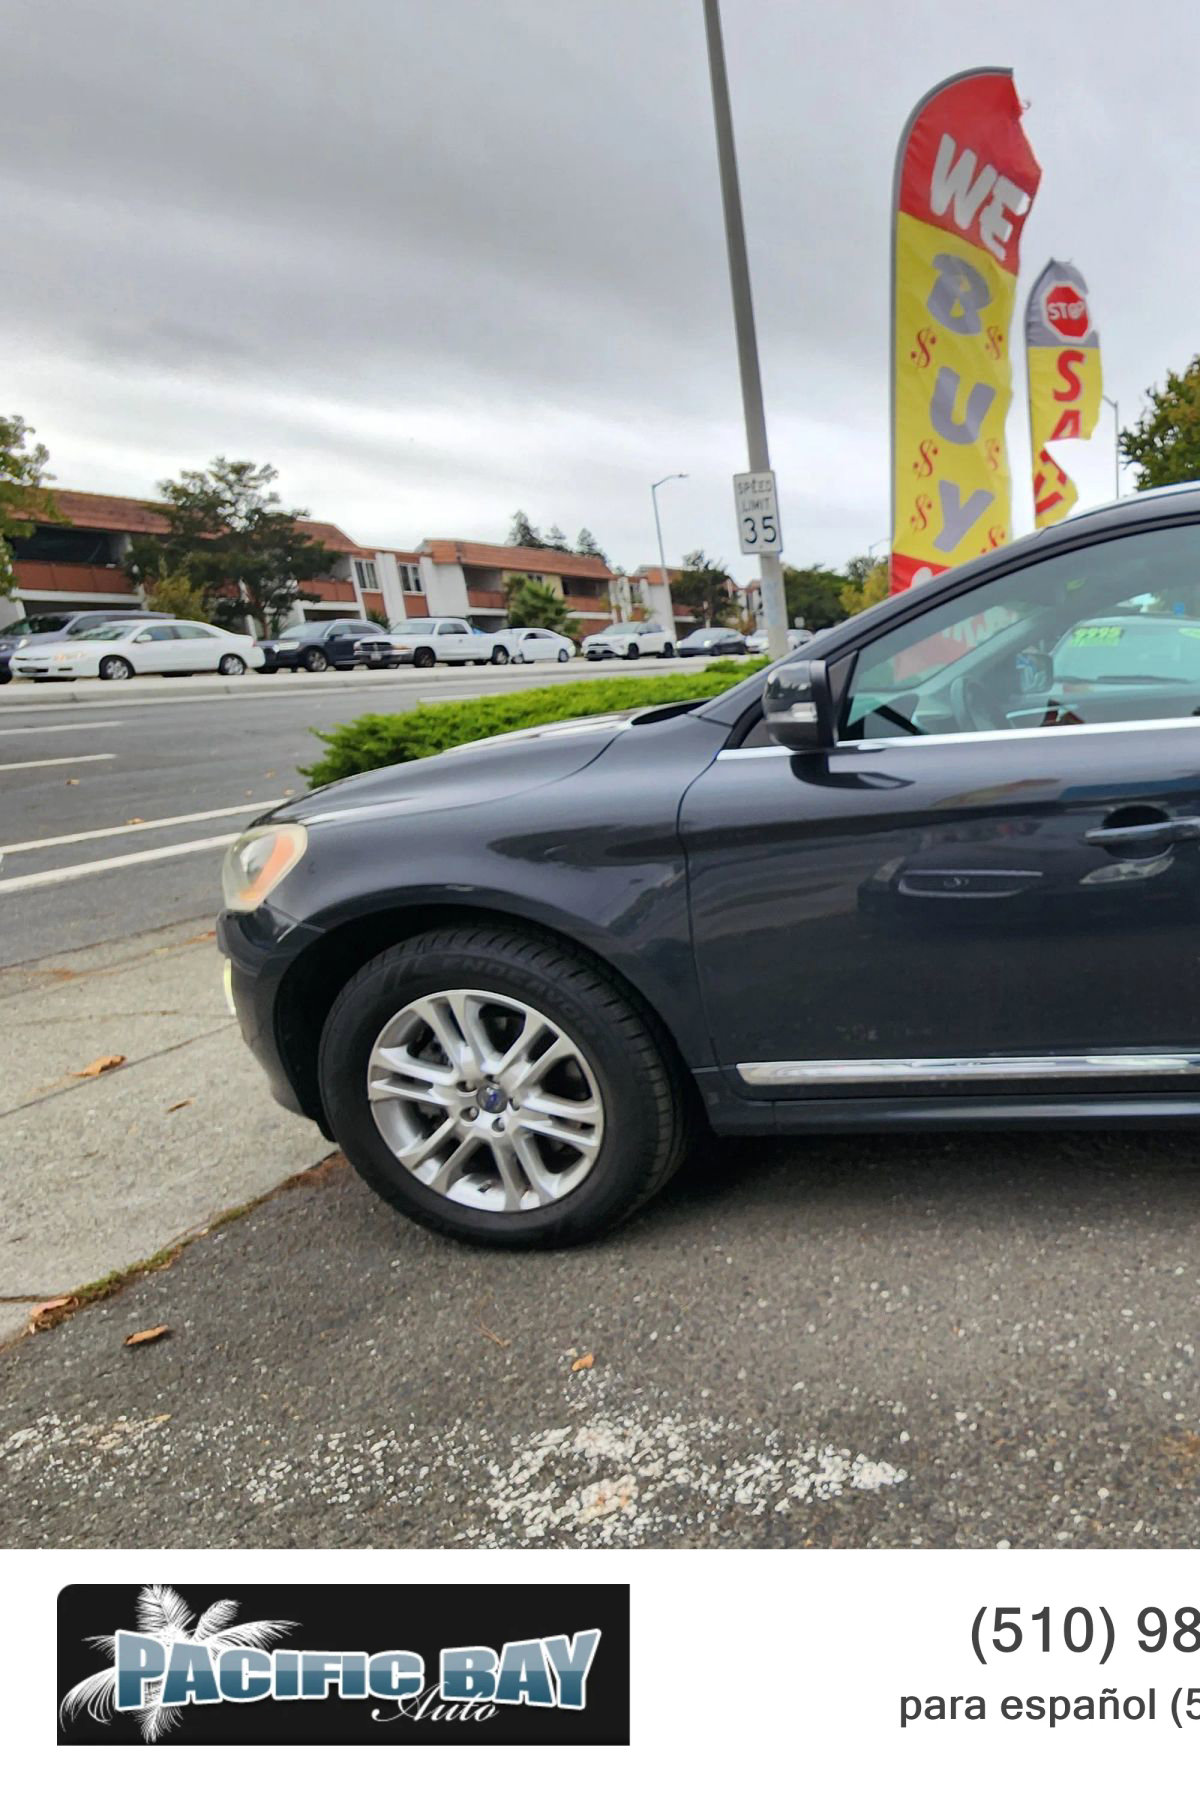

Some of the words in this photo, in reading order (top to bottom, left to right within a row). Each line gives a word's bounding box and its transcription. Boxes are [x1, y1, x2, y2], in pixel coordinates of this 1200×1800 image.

[930, 133, 1030, 262] WE
[926, 252, 997, 554] BUY
[743, 515, 777, 544] 35
